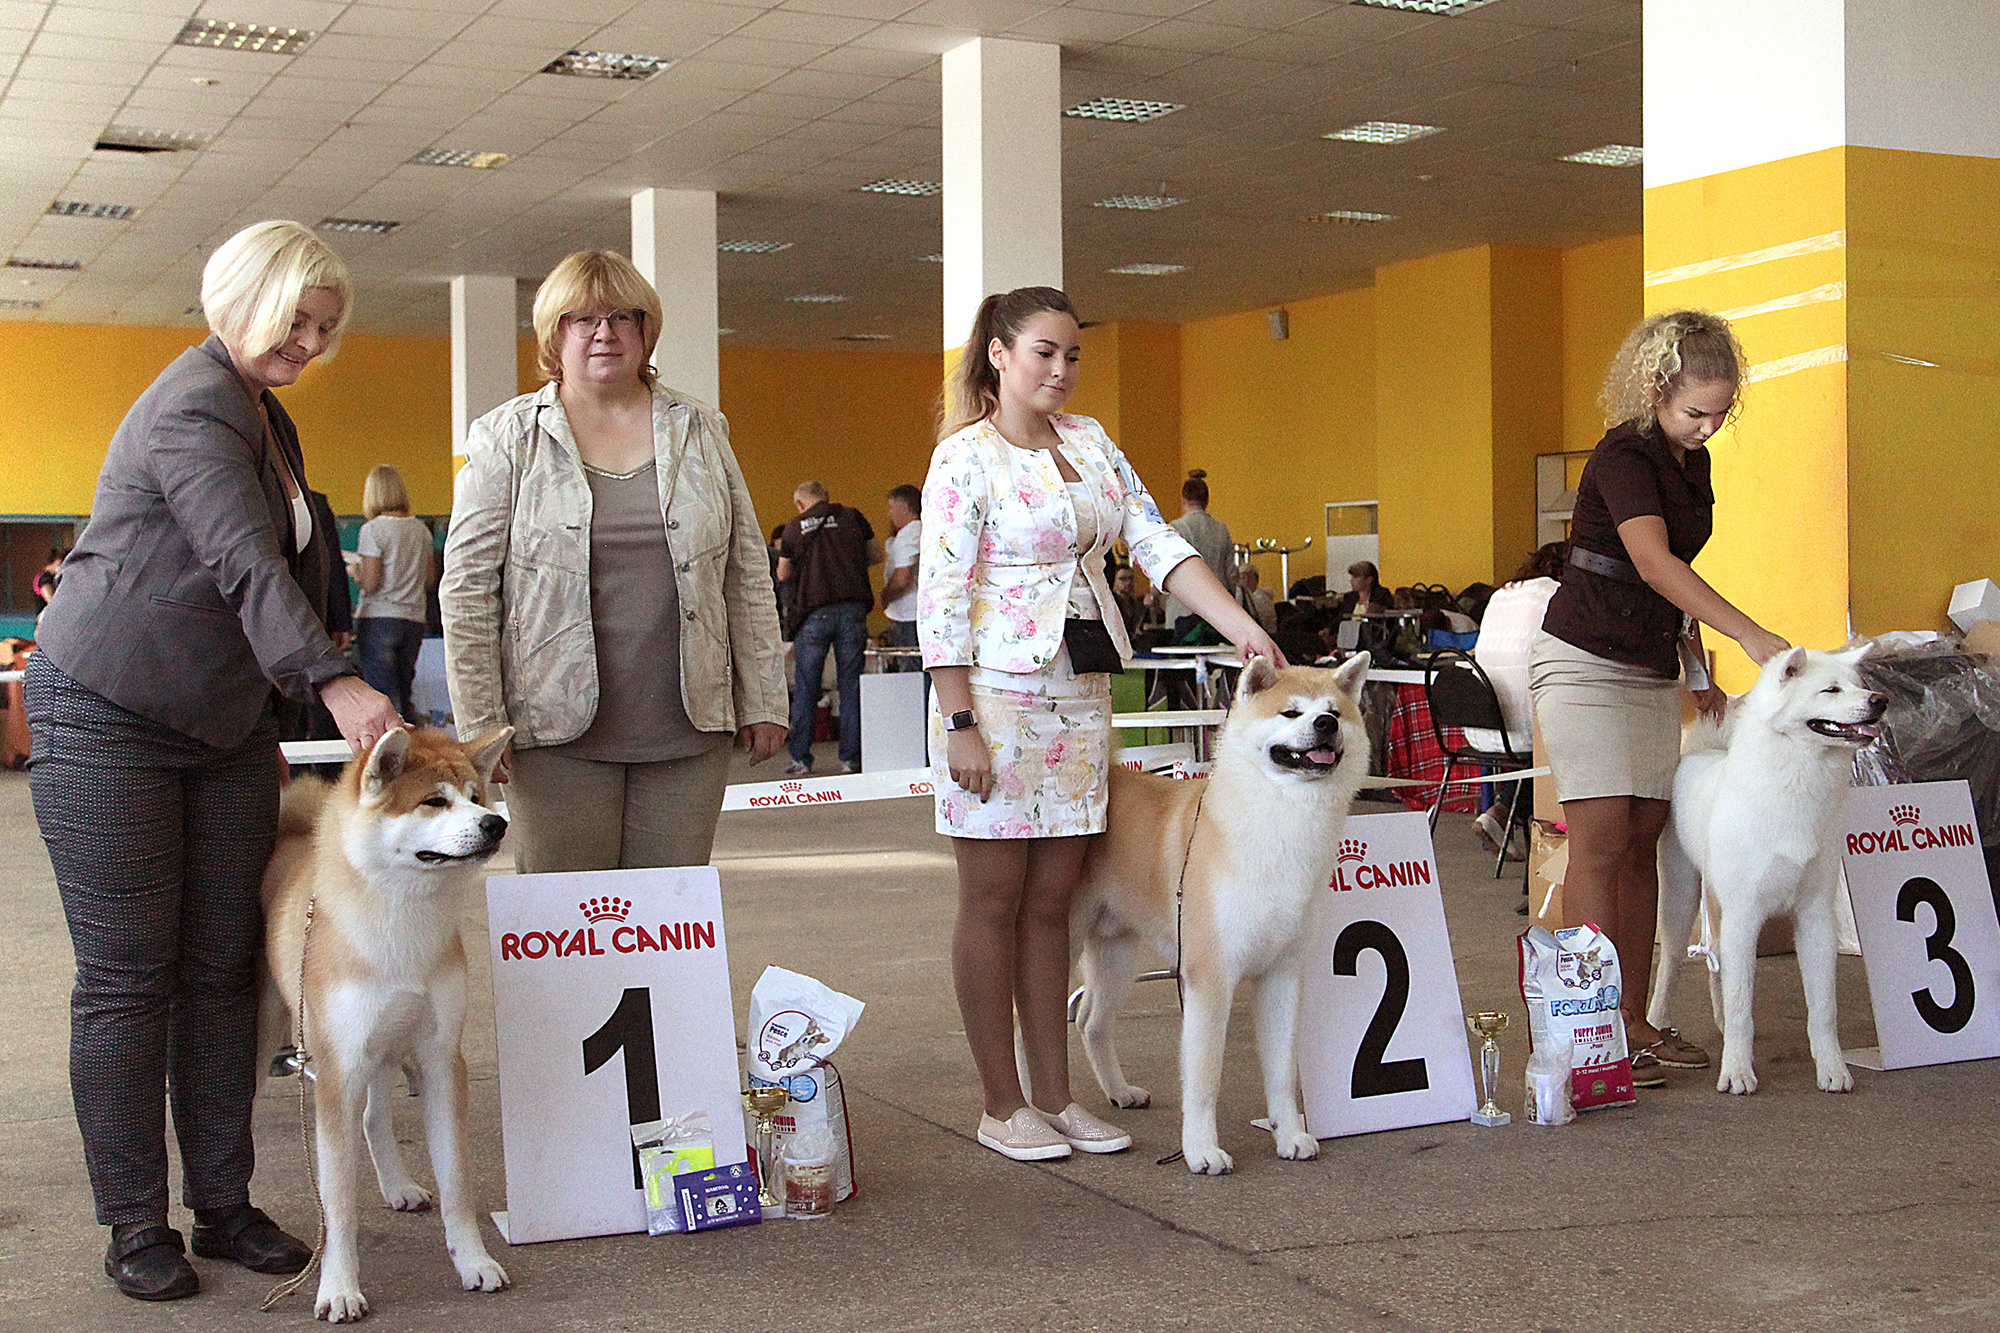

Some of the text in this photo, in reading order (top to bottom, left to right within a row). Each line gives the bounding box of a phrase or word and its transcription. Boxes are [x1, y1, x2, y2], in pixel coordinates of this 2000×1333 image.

[750, 790, 842, 807] ROYAL CANIN
[909, 782, 935, 795] ROY
[1846, 823, 1975, 856] ROYAL CANIN
[1355, 859, 1431, 890] CANIN
[501, 920, 716, 961] ROYAL CANIN
[1896, 876, 1976, 1035] 3
[1333, 919, 1430, 1099] 2
[1573, 1027, 1594, 1038] PUPPY
[582, 986, 662, 1190] 1
